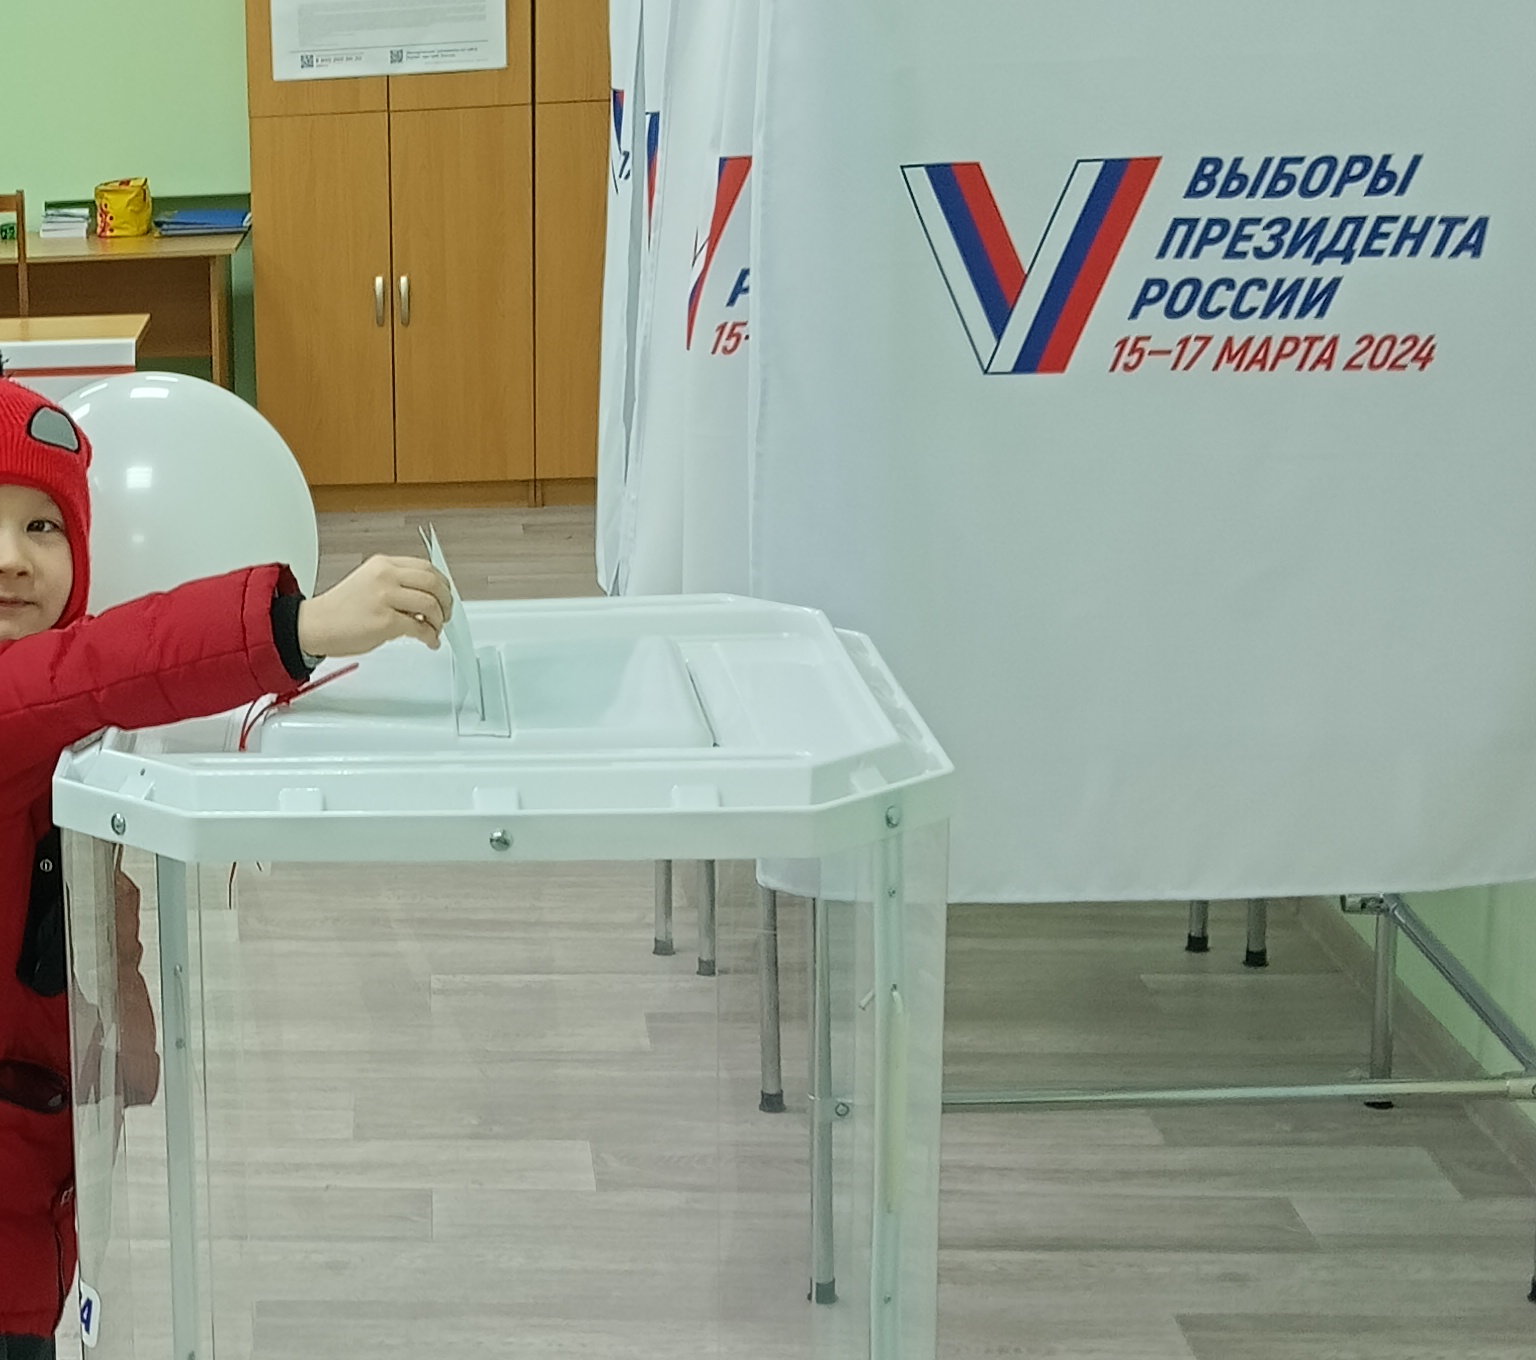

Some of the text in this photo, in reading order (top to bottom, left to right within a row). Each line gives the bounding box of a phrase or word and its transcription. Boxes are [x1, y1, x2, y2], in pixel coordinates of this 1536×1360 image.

[1182, 153, 1423, 201] ВЫБОРЫ
[1155, 215, 1491, 266] ПРЕЗИДЕНТА
[1127, 276, 1343, 321] РОССИИ
[1108, 332, 1436, 375] 15–17 МАРТА 2024
